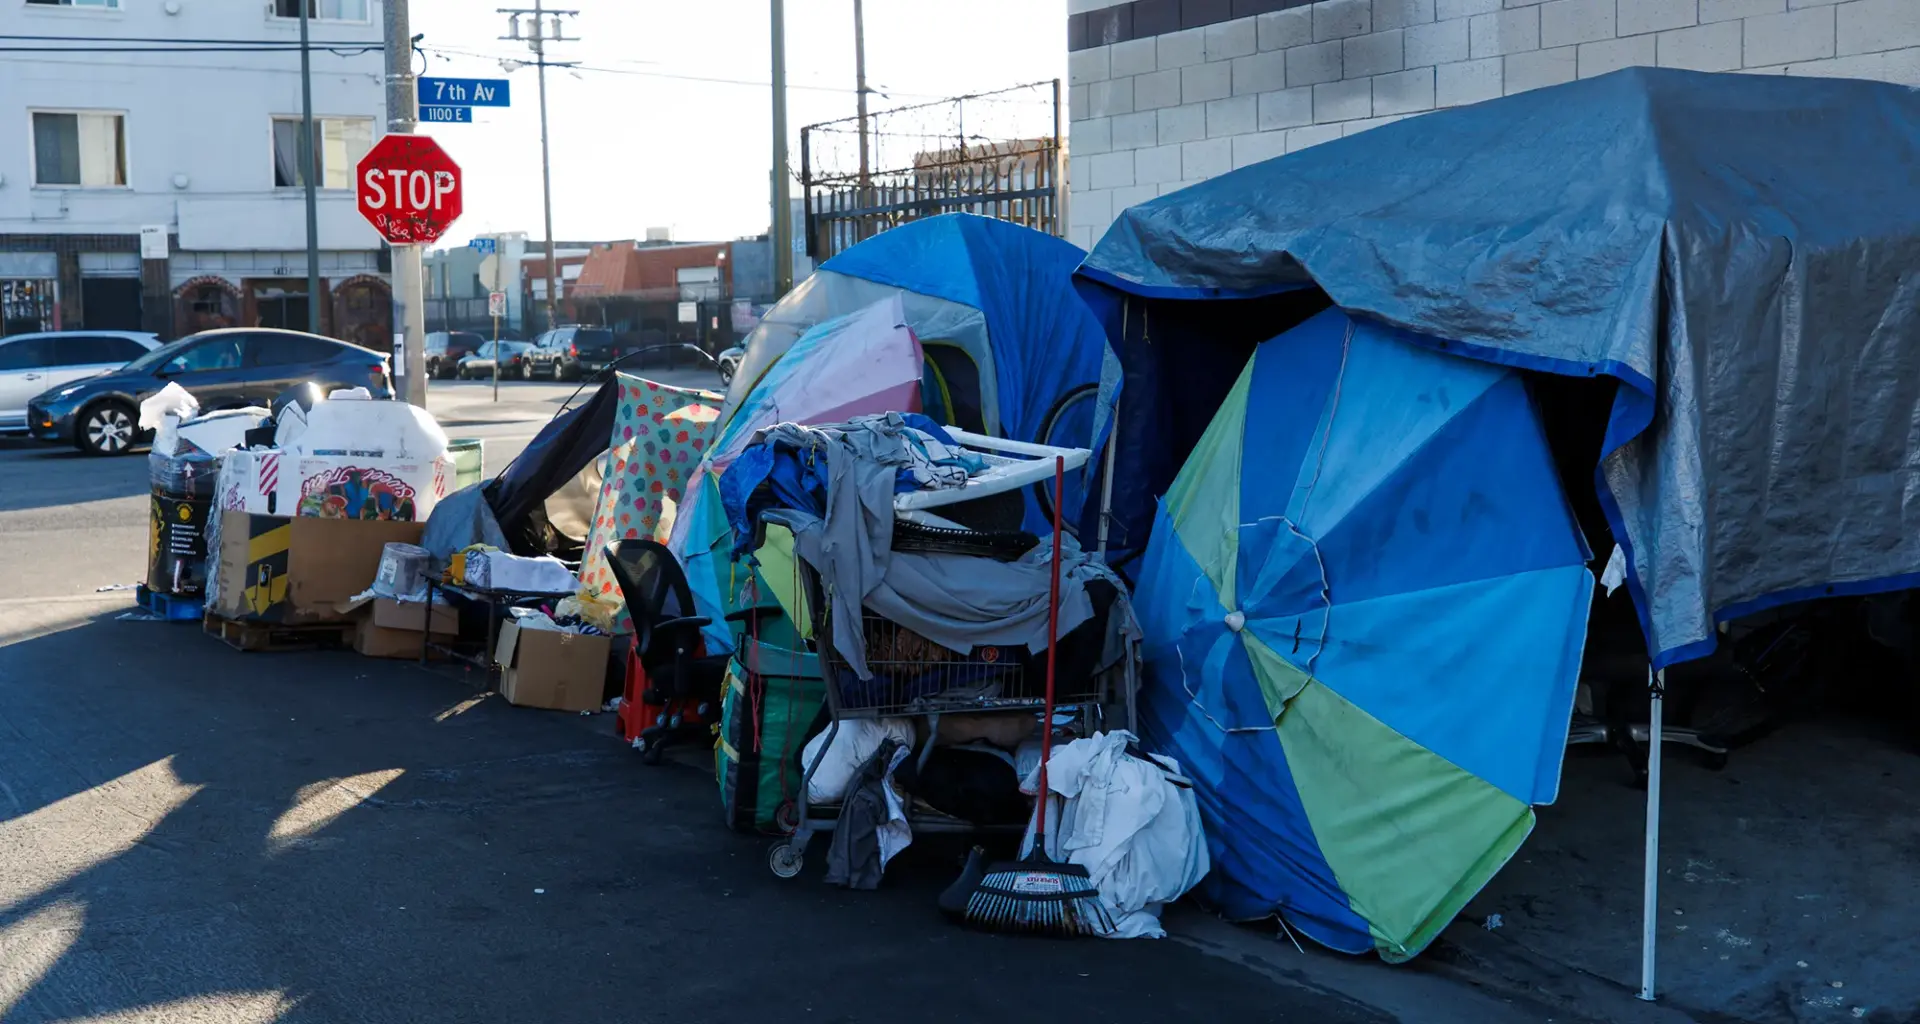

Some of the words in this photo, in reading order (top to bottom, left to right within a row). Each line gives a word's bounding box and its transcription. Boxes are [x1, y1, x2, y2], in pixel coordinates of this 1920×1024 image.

[433, 81, 466, 101] 7th
[473, 82, 495, 101] Av
[428, 107, 453, 121] 1100
[455, 108, 463, 121] E
[364, 168, 456, 210] STOP
[302, 466, 356, 496] Treat
[361, 468, 415, 498] Sweet
